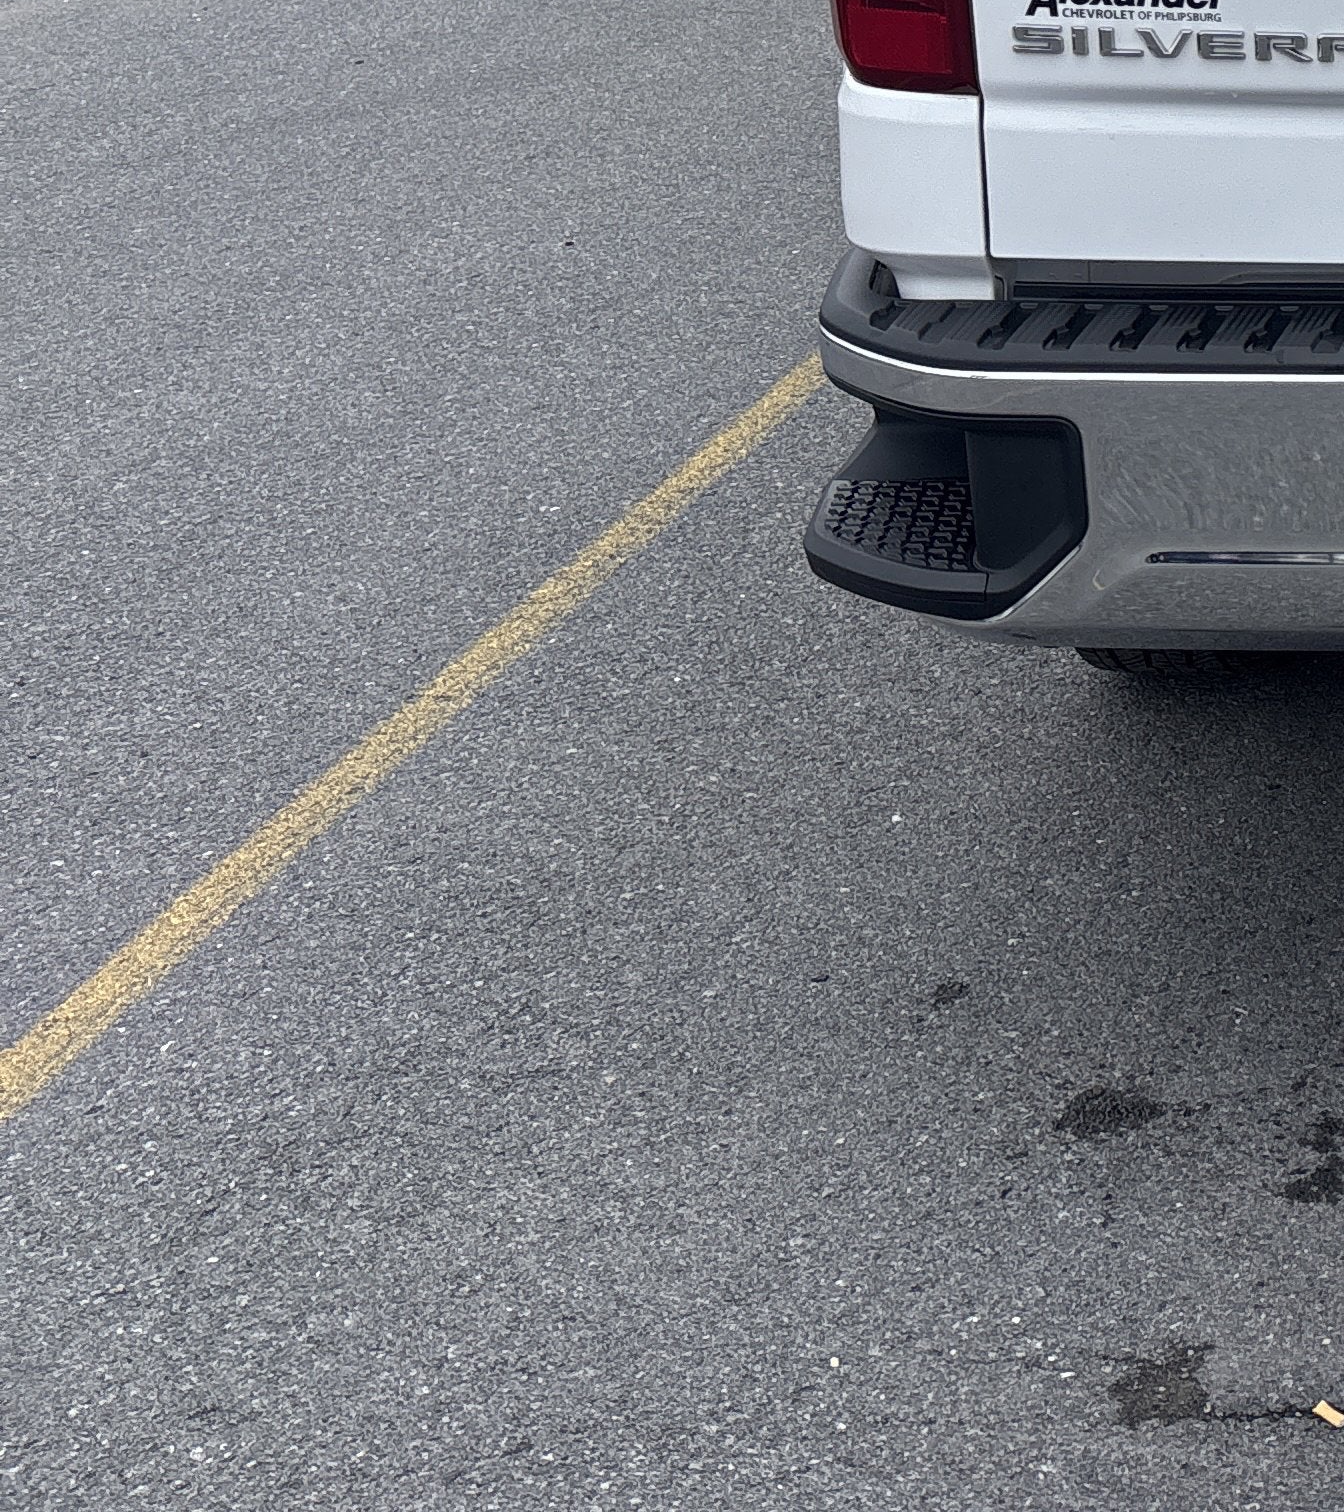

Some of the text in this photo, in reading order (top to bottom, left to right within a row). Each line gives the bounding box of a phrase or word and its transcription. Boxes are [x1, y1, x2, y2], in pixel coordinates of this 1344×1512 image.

[1062, 7, 1223, 23] CHEVROLET OF PHILIPSBURG
